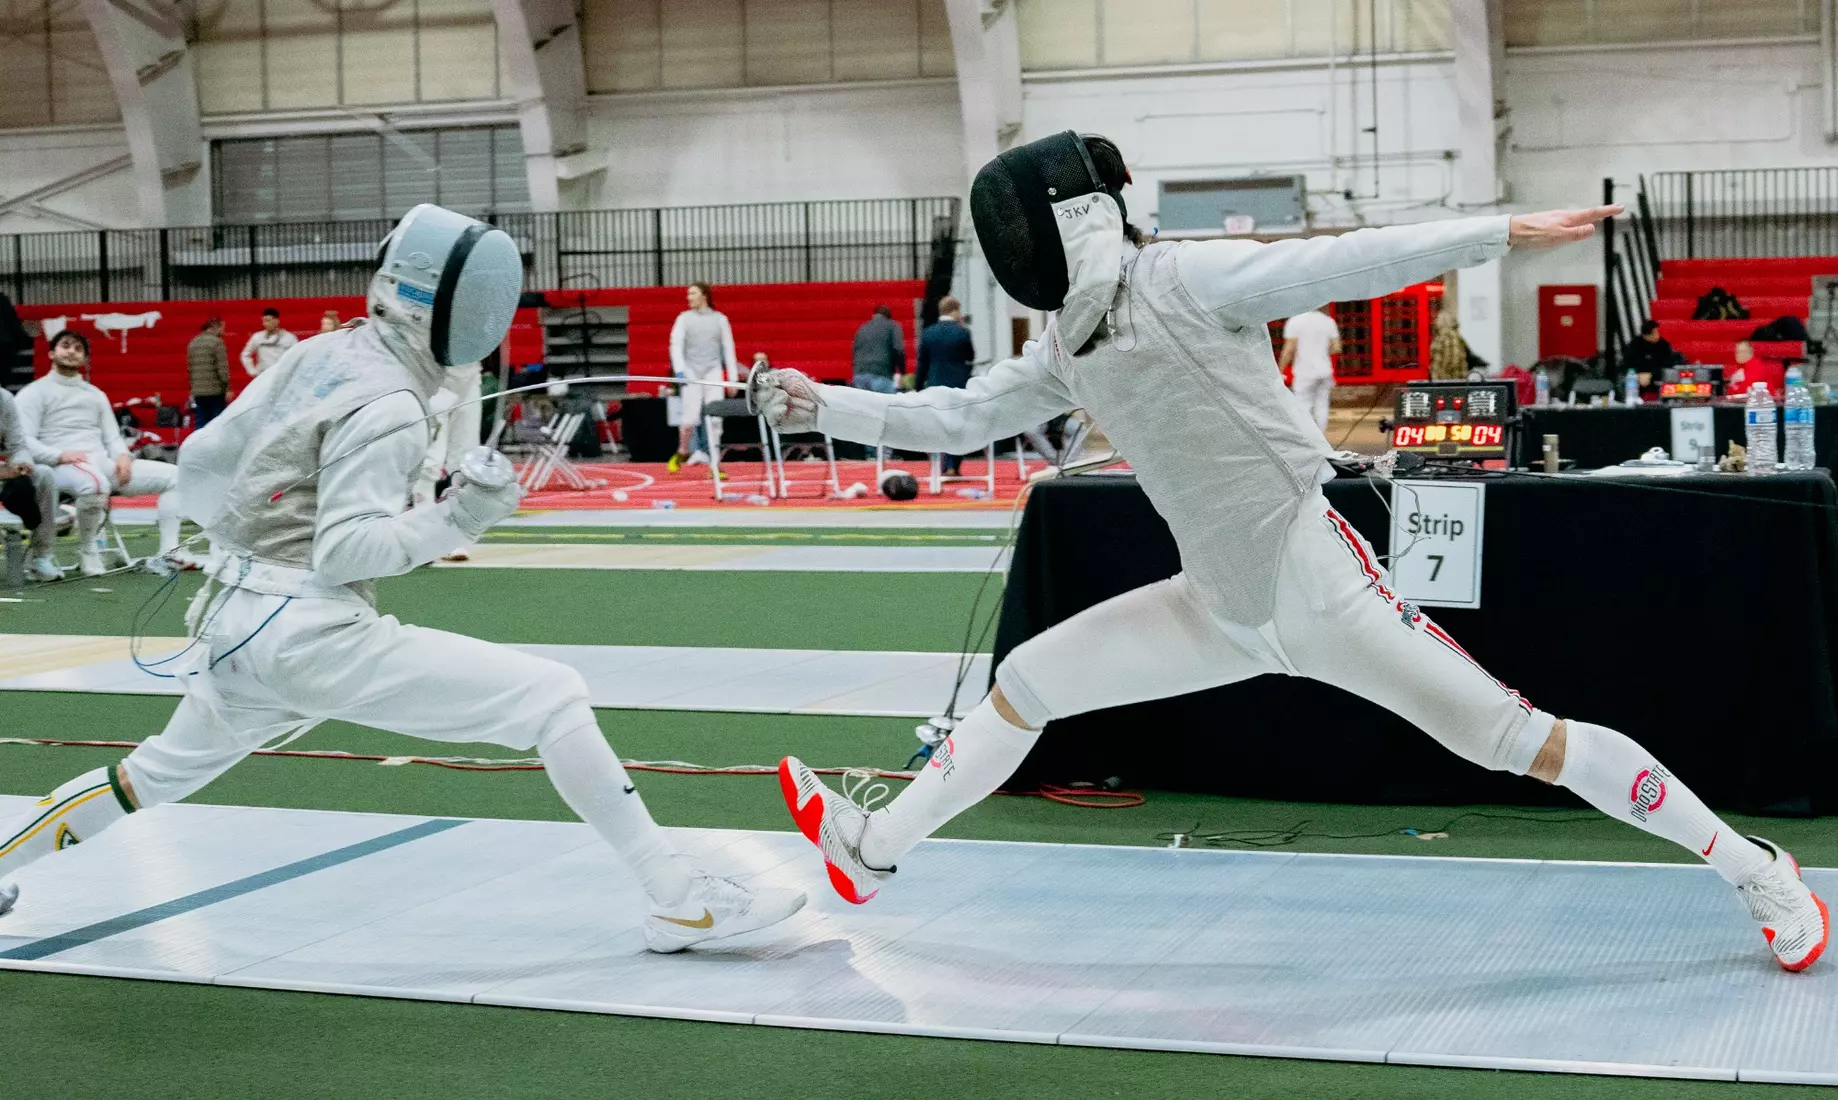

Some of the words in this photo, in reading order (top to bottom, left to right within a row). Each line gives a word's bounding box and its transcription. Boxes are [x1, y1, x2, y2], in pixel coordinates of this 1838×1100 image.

[1065, 204, 1090, 219] JKV
[1396, 426, 1424, 446] 04
[1473, 425, 1502, 445] 04
[1408, 512, 1464, 541] Strip
[1427, 554, 1445, 581] 7
[1631, 794, 1650, 822] OHIO
[1641, 765, 1671, 798] STATE
